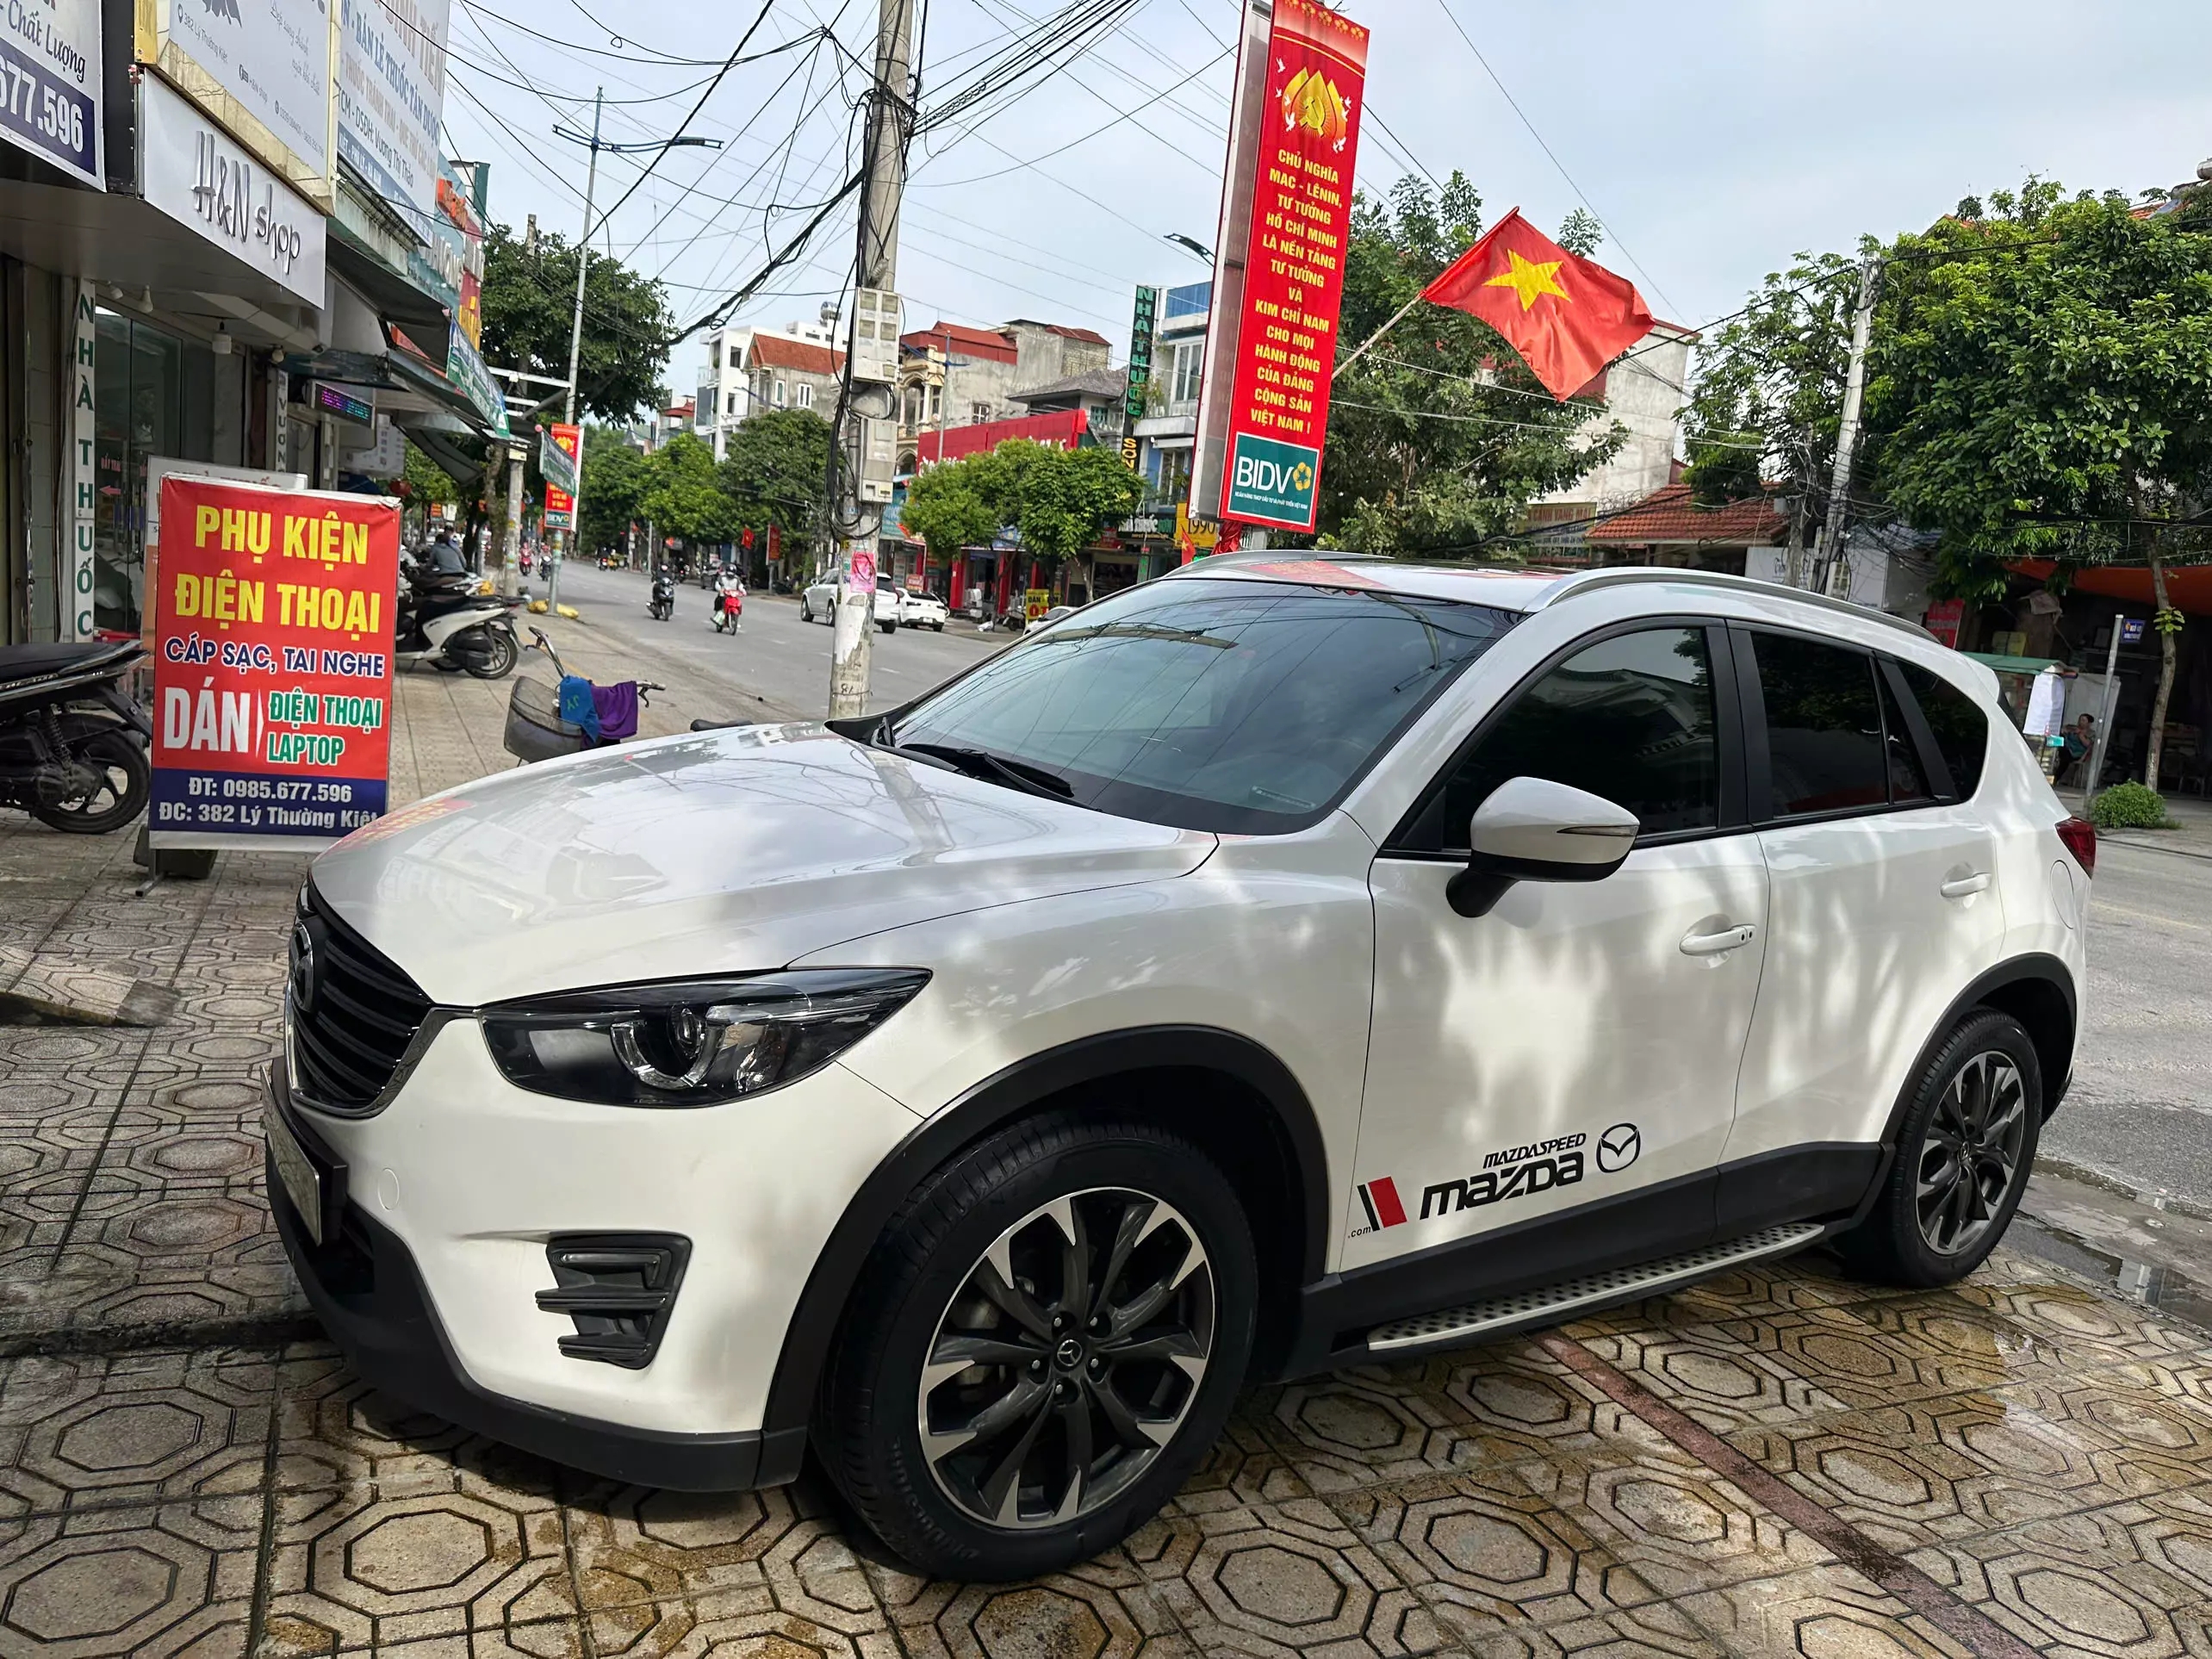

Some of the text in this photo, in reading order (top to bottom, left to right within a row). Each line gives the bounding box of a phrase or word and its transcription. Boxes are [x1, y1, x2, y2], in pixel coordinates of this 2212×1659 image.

[183, 12, 194, 31] 382
[8, 0, 41, 47] Chất
[46, 24, 85, 84] Lượng
[386, 52, 409, 105] THUỐC
[375, 128, 392, 168] Vương
[393, 146, 401, 179] Thị
[401, 158, 413, 188] Thảo
[1278, 148, 1339, 183] CHỦ NGHĨA
[190, 131, 251, 243] H&N
[255, 183, 301, 275] shop
[1270, 168, 1296, 190] MAC
[1307, 183, 1342, 208] LÊNIN,
[1277, 193, 1331, 225] TƯ TƯỞNG
[1266, 211, 1337, 248] HỒ CHÍ MINH
[1263, 234, 1336, 270] LÀ NỀN TẢNG
[1271, 259, 1324, 287] TƯ TƯỞNG
[1134, 287, 1153, 333] NHÀ
[1289, 287, 1302, 303] VÀ
[1255, 300, 1329, 332] KIM CHỈ NAM
[1266, 325, 1314, 351] CHO MỌI
[1255, 344, 1320, 374] HÀNH ĐỘNG
[1257, 363, 1314, 393] CỦA ĐẢNG
[1254, 388, 1312, 413] CỘNG SẢN
[1251, 408, 1275, 427] VIỆT
[1277, 413, 1303, 432] NAM
[77, 293, 94, 638] NHÀ THUỐC
[1236, 457, 1294, 494] BIDV
[196, 505, 368, 571] PHỤ KIỆN
[175, 569, 380, 641] ĐIỆN THOẠI
[165, 632, 384, 677] CÁP SẠC, TAI NGHE
[164, 676, 251, 753] DÁN
[269, 688, 382, 732] ĐIỆN THOẠI
[267, 734, 345, 765] LAPTOP
[189, 778, 352, 802] ĐT: 0985.677.596
[159, 802, 191, 821] ĐC:
[198, 805, 234, 823] 382
[240, 805, 261, 825] Lý
[267, 806, 335, 829] Thường
[1482, 1133, 1587, 1169] MAZDASPEED
[1419, 1152, 1584, 1220] mazda
[1348, 1226, 1371, 1239] .com
